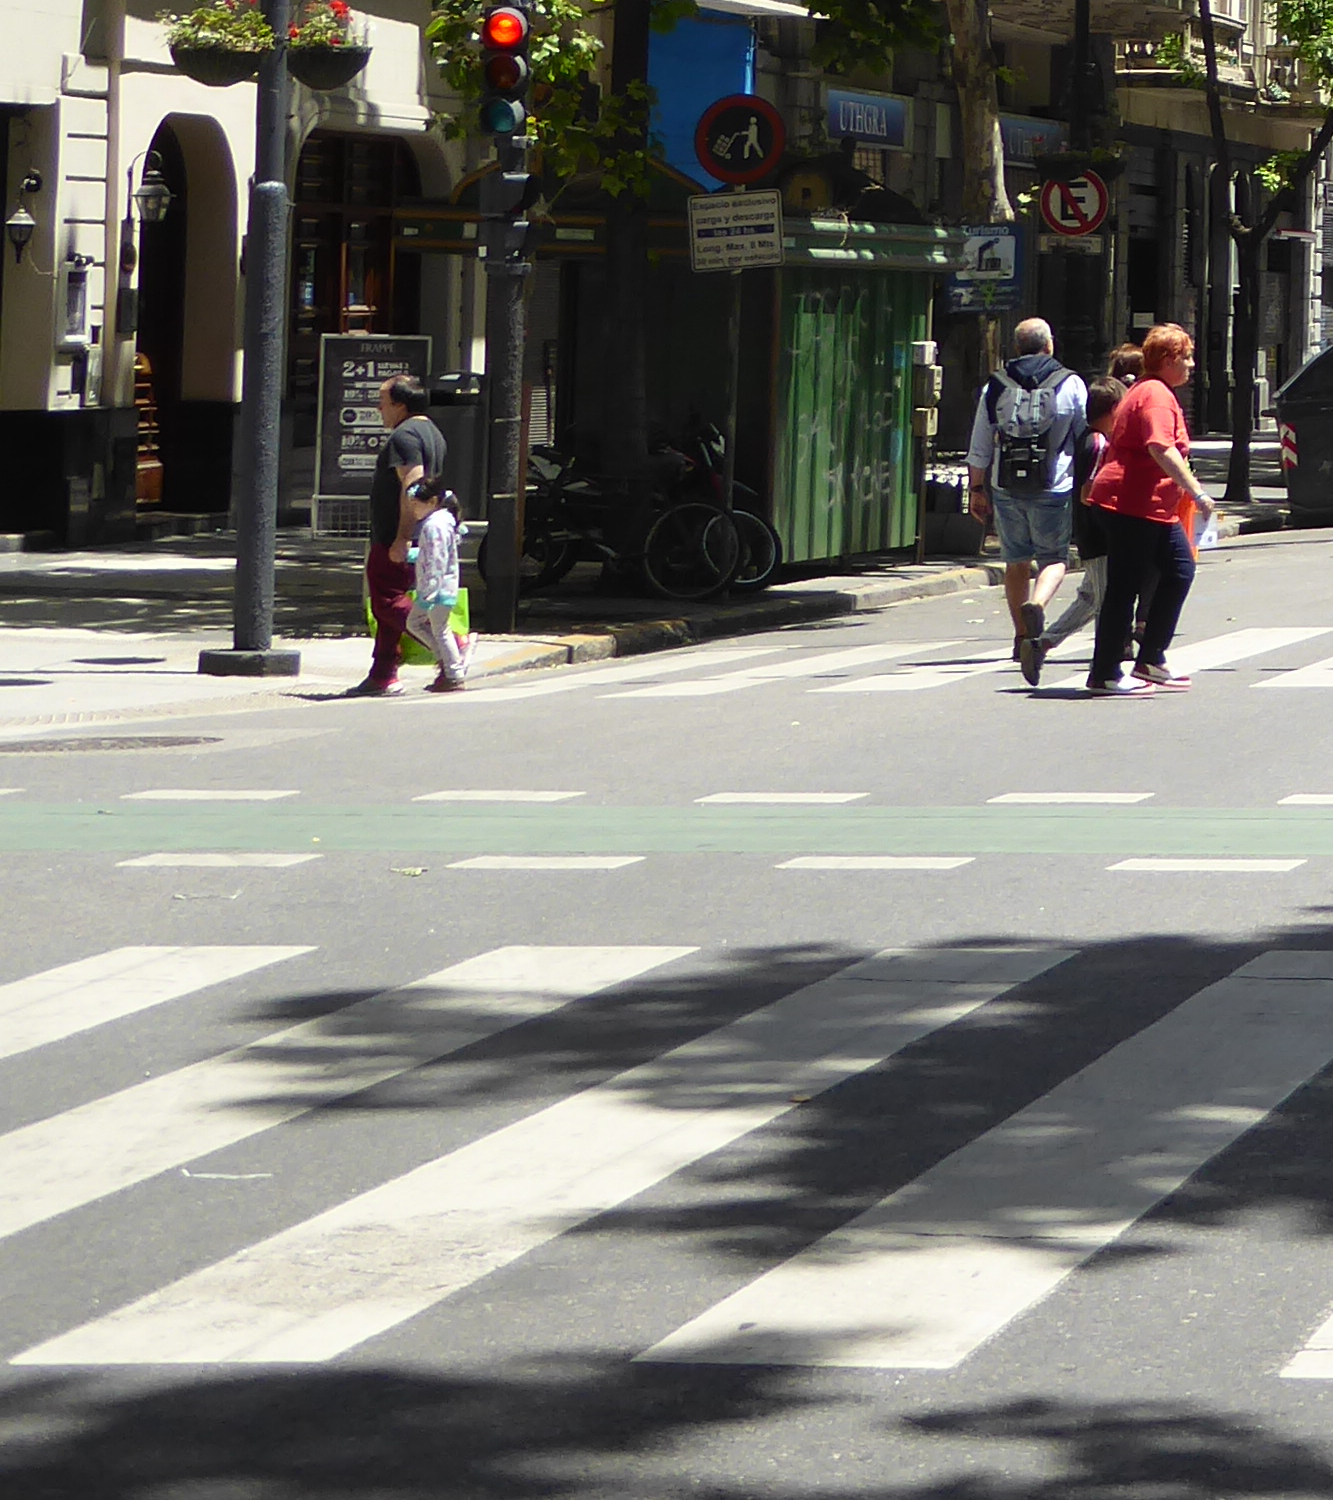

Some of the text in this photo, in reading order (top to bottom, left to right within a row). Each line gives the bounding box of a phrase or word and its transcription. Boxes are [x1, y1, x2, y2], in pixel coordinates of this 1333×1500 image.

[839, 100, 888, 137] UTHGRA
[1061, 181, 1088, 220] E
[724, 216, 730, 224] y
[732, 212, 775, 222] descarga
[342, 360, 375, 378] 2+1
